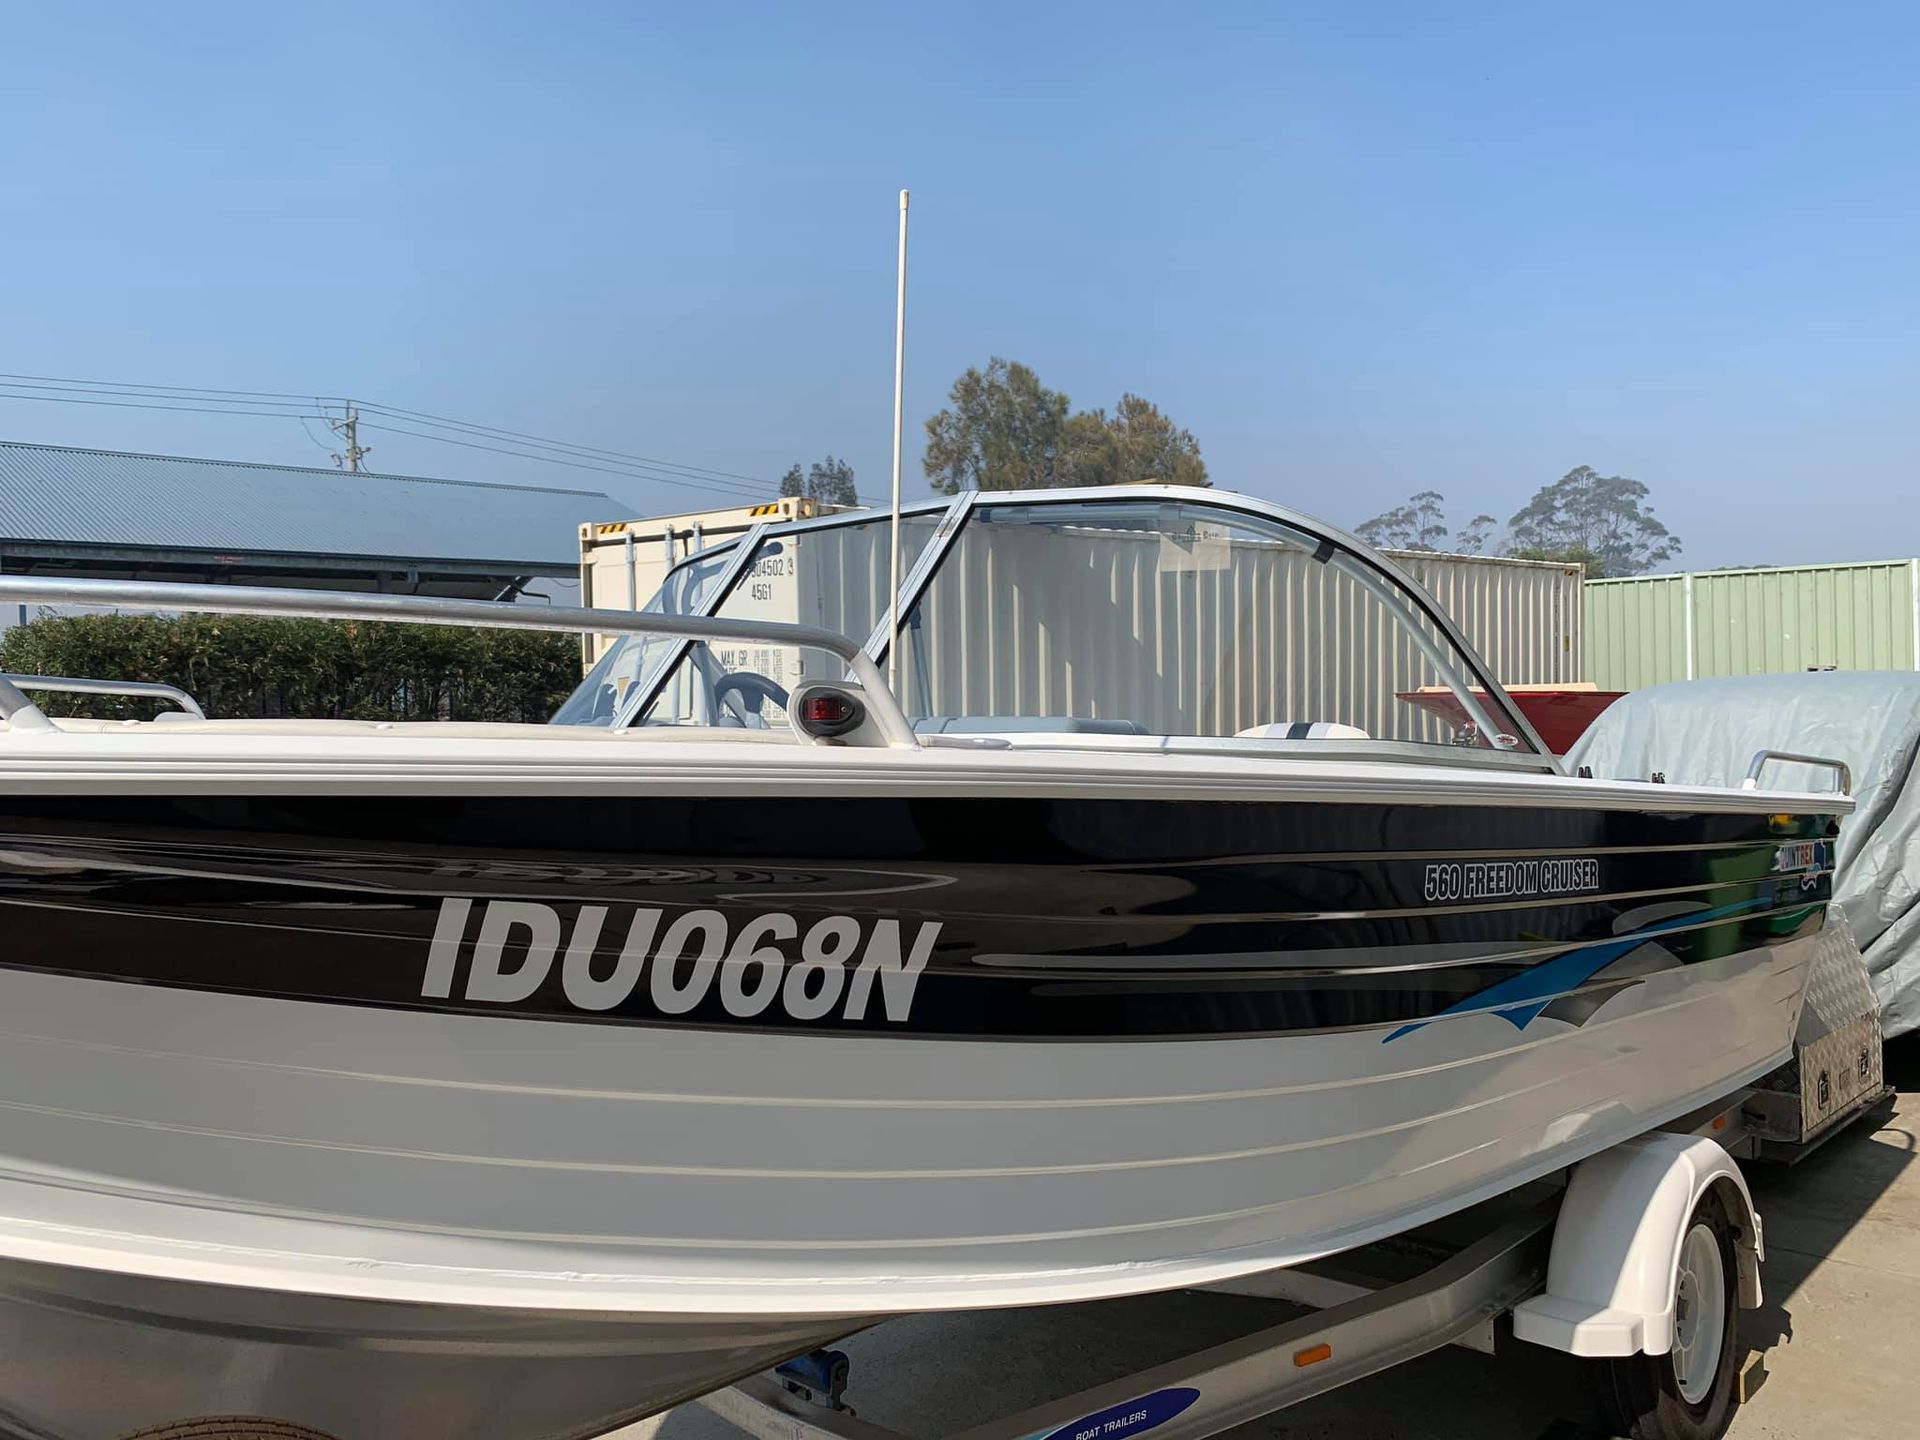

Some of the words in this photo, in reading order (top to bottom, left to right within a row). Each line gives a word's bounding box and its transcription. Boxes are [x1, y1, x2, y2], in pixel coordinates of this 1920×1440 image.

[788, 557, 793, 575] 3
[752, 584, 771, 600] 45G1
[721, 650, 734, 665] MAX
[1425, 865, 1461, 900] 560
[1464, 862, 1538, 898] FREEDOM
[1540, 859, 1598, 893] CRUISER
[421, 898, 943, 1021] IDU068N
[1076, 1426, 1100, 1440] BOAT
[1104, 1410, 1147, 1432] TRAILERS
